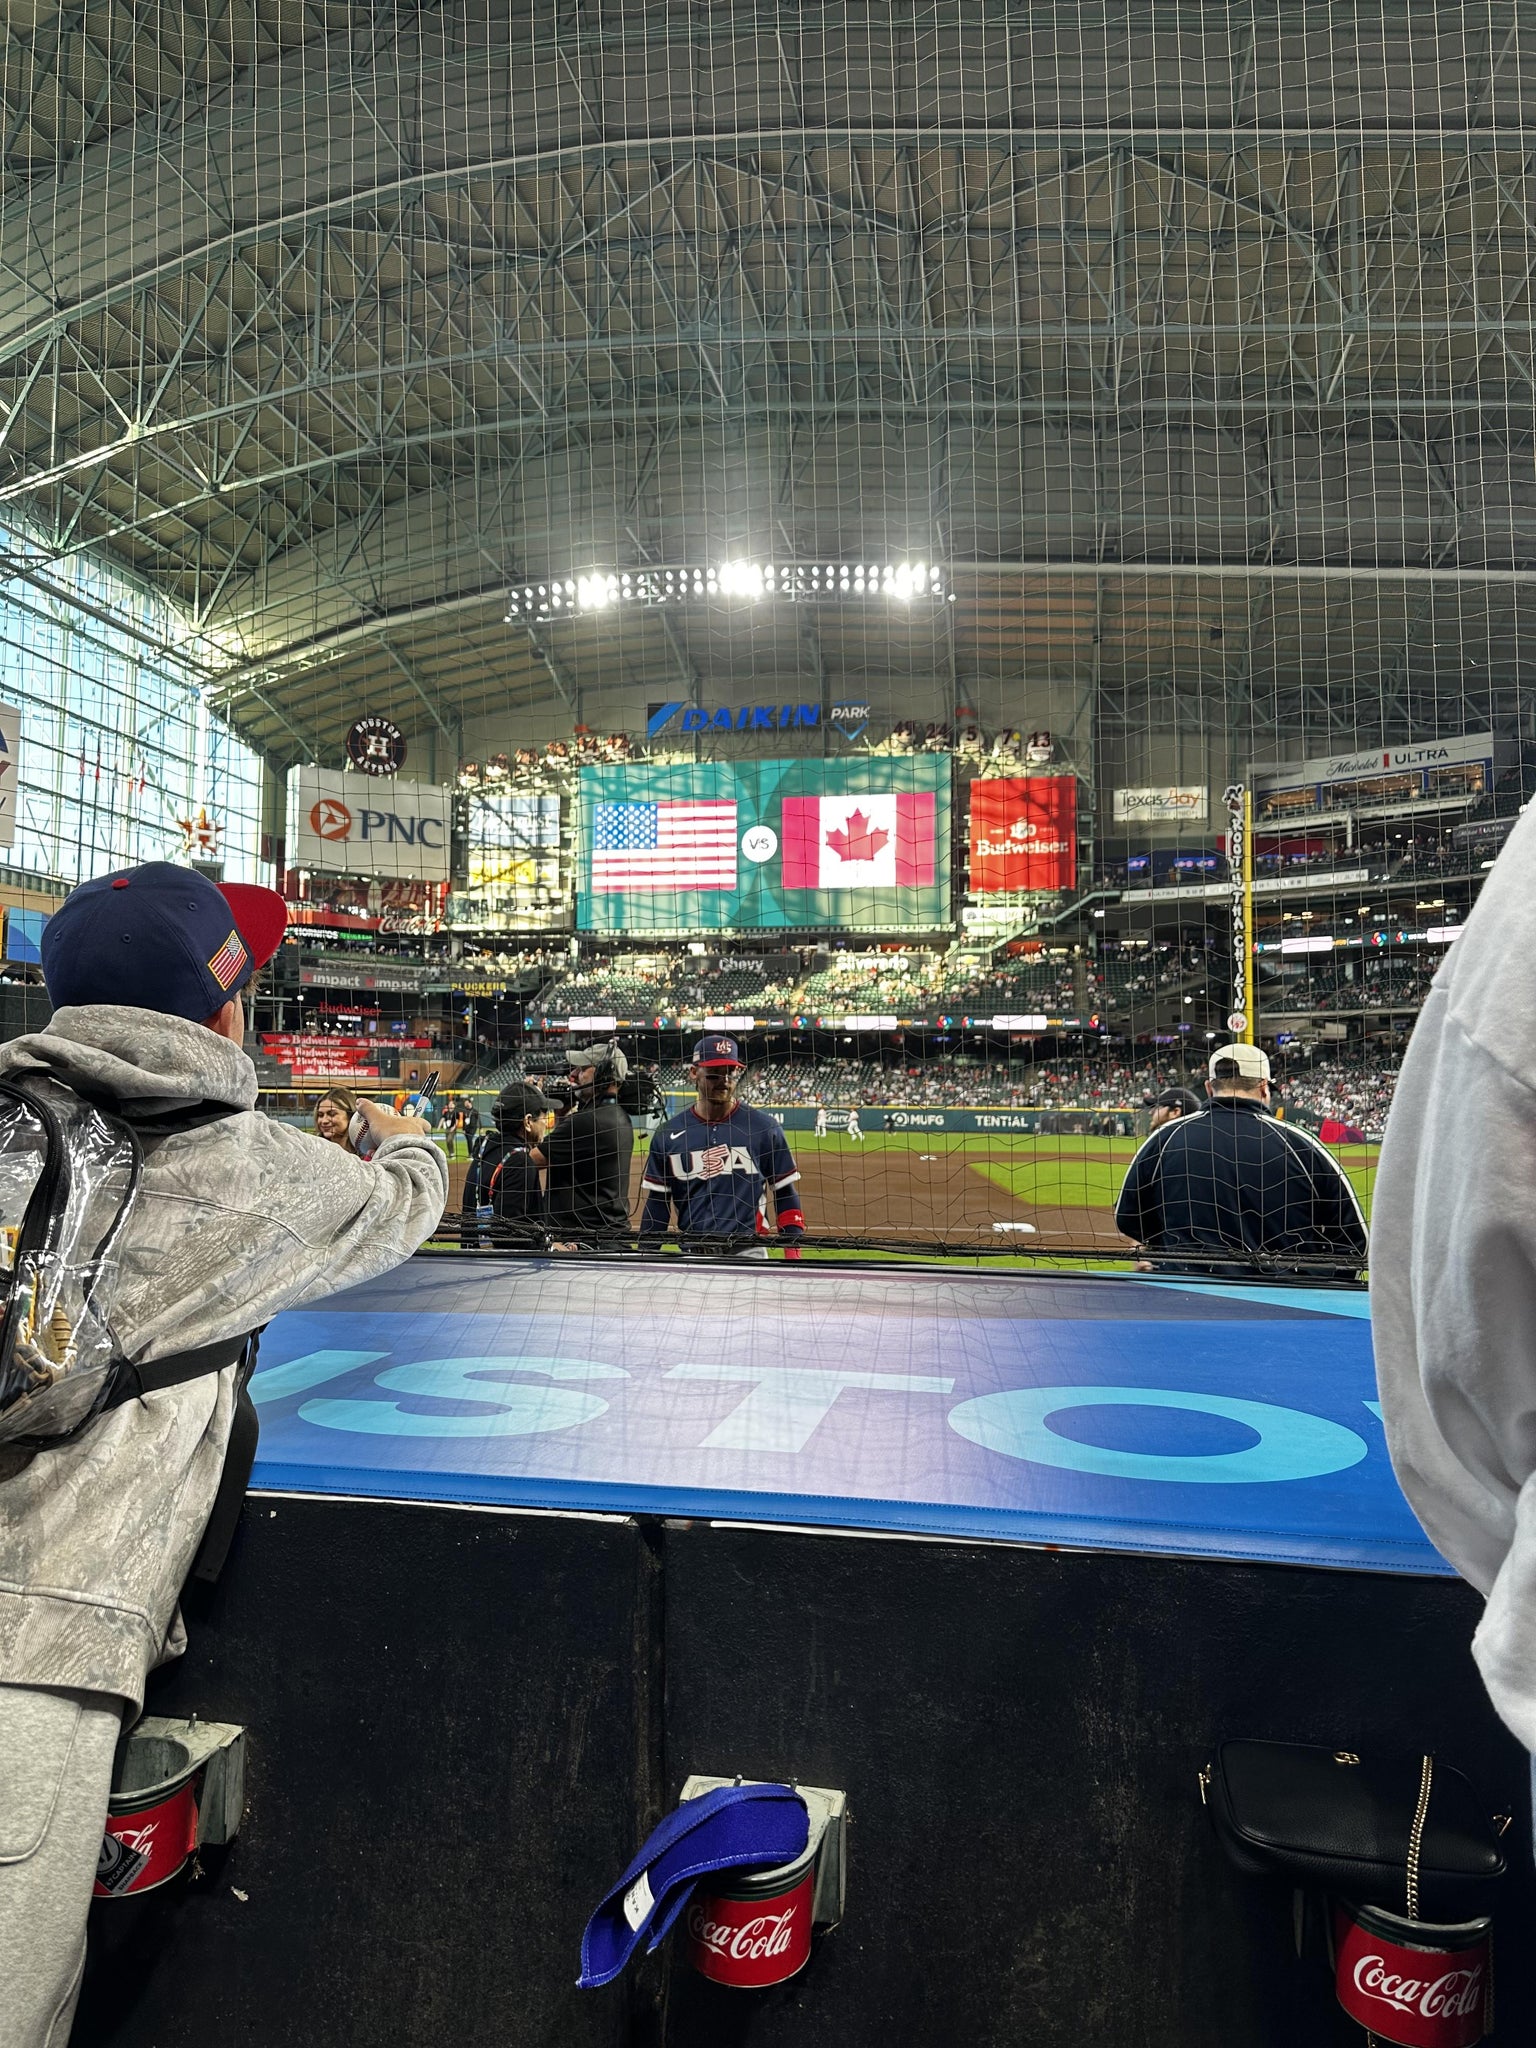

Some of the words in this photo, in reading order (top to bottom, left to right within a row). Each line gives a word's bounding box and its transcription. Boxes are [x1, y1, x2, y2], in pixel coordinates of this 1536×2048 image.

[681, 704, 821, 732] DAIKIN
[830, 706, 871, 721] PARK
[355, 718, 401, 740] HOUSTON
[966, 725, 977, 742] 5
[1001, 728, 1012, 745] 7
[366, 734, 390, 757] H
[1028, 730, 1050, 747] 13
[356, 756, 398, 774] ASTROS
[1325, 757, 1379, 777] Michelob
[1394, 747, 1449, 766] ULTRA
[1119, 791, 1163, 807] Texas
[1169, 787, 1200, 808] Bay
[357, 807, 444, 849] PNC
[749, 837, 770, 850] VS
[1230, 818, 1244, 868] ROOT
[1230, 890, 1246, 931] THA
[718, 957, 764, 971] Chevy
[836, 955, 909, 972] Silverado
[1232, 934, 1246, 1011] CHIKIN
[312, 974, 361, 989] impact
[374, 979, 420, 992] impact
[451, 982, 507, 991] PLUCKERS
[319, 1001, 382, 1016] Budweiser
[292, 1034, 342, 1046] Budweiser
[368, 1038, 416, 1049] Budweiser
[317, 1065, 369, 1077] Budweiser
[910, 1114, 945, 1127] MUFG
[974, 1115, 1029, 1128] TENTIAL
[668, 1143, 760, 1182] USA
[687, 1904, 798, 1960] Coca-Cola
[1352, 1953, 1482, 2020] Coca-Cola
